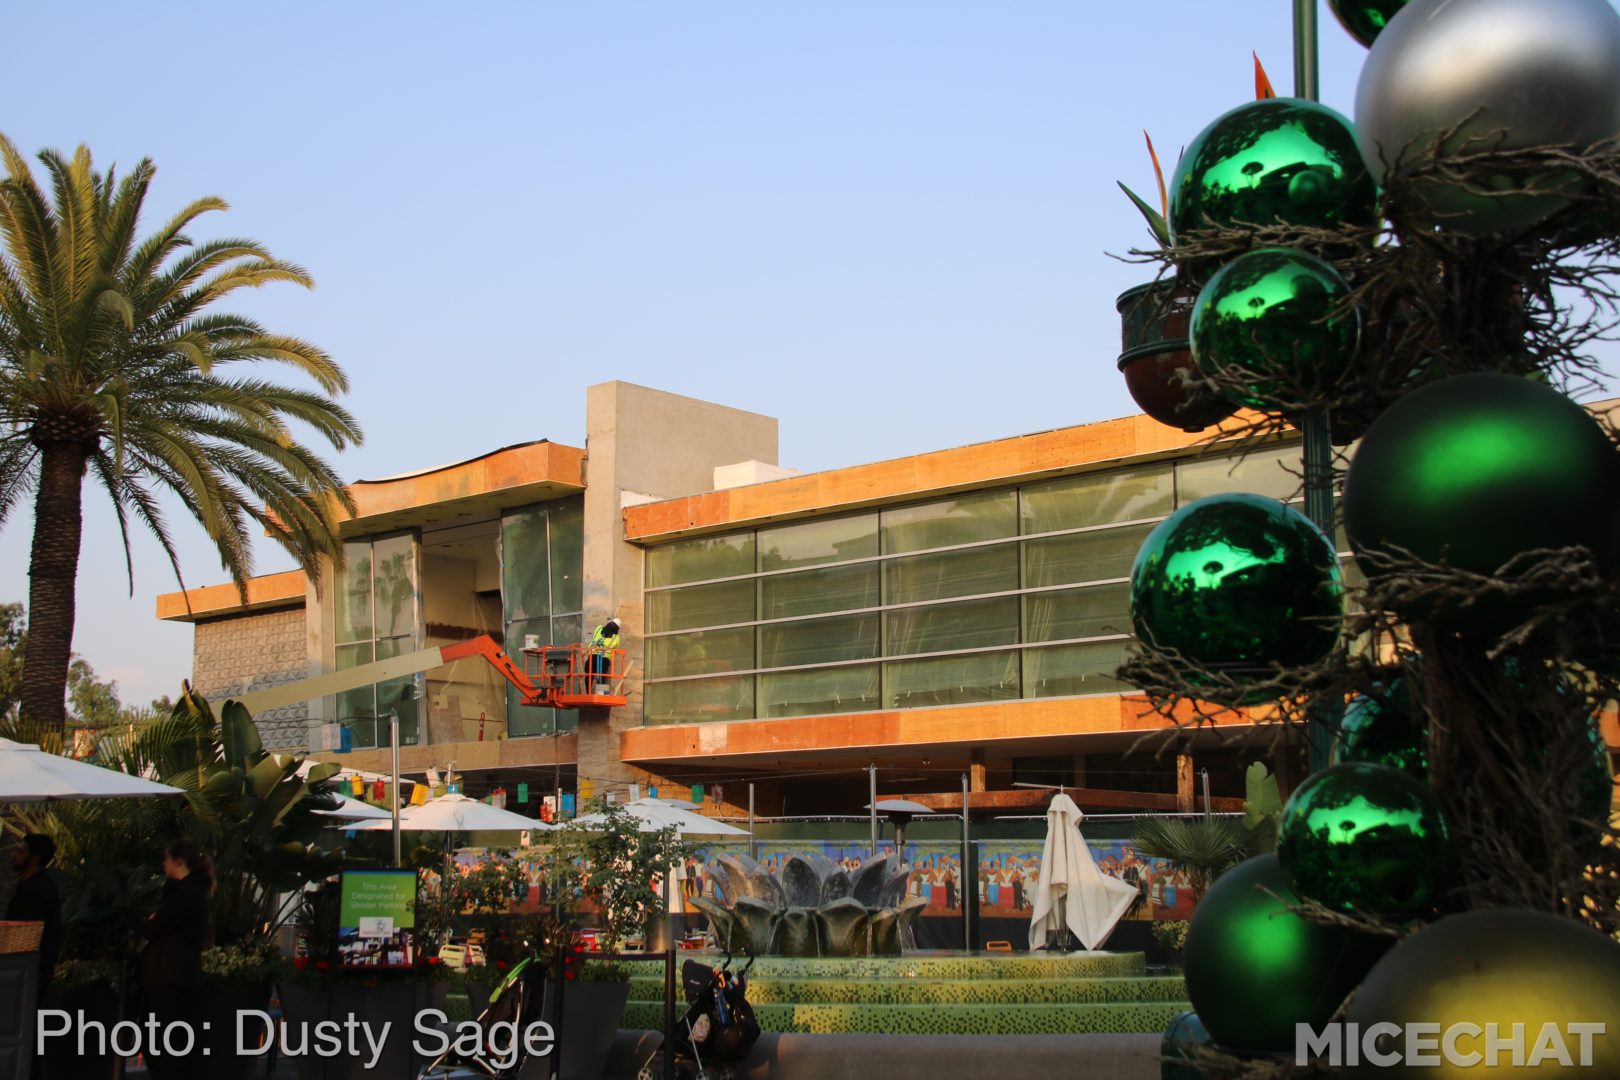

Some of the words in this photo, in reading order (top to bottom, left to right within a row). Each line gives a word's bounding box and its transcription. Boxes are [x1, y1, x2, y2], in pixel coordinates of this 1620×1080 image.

[362, 883, 377, 891] This
[379, 883, 397, 891] Area
[351, 892, 393, 901] Designated
[395, 892, 406, 900] for
[351, 901, 376, 909] Stroller
[378, 902, 407, 911] Parking
